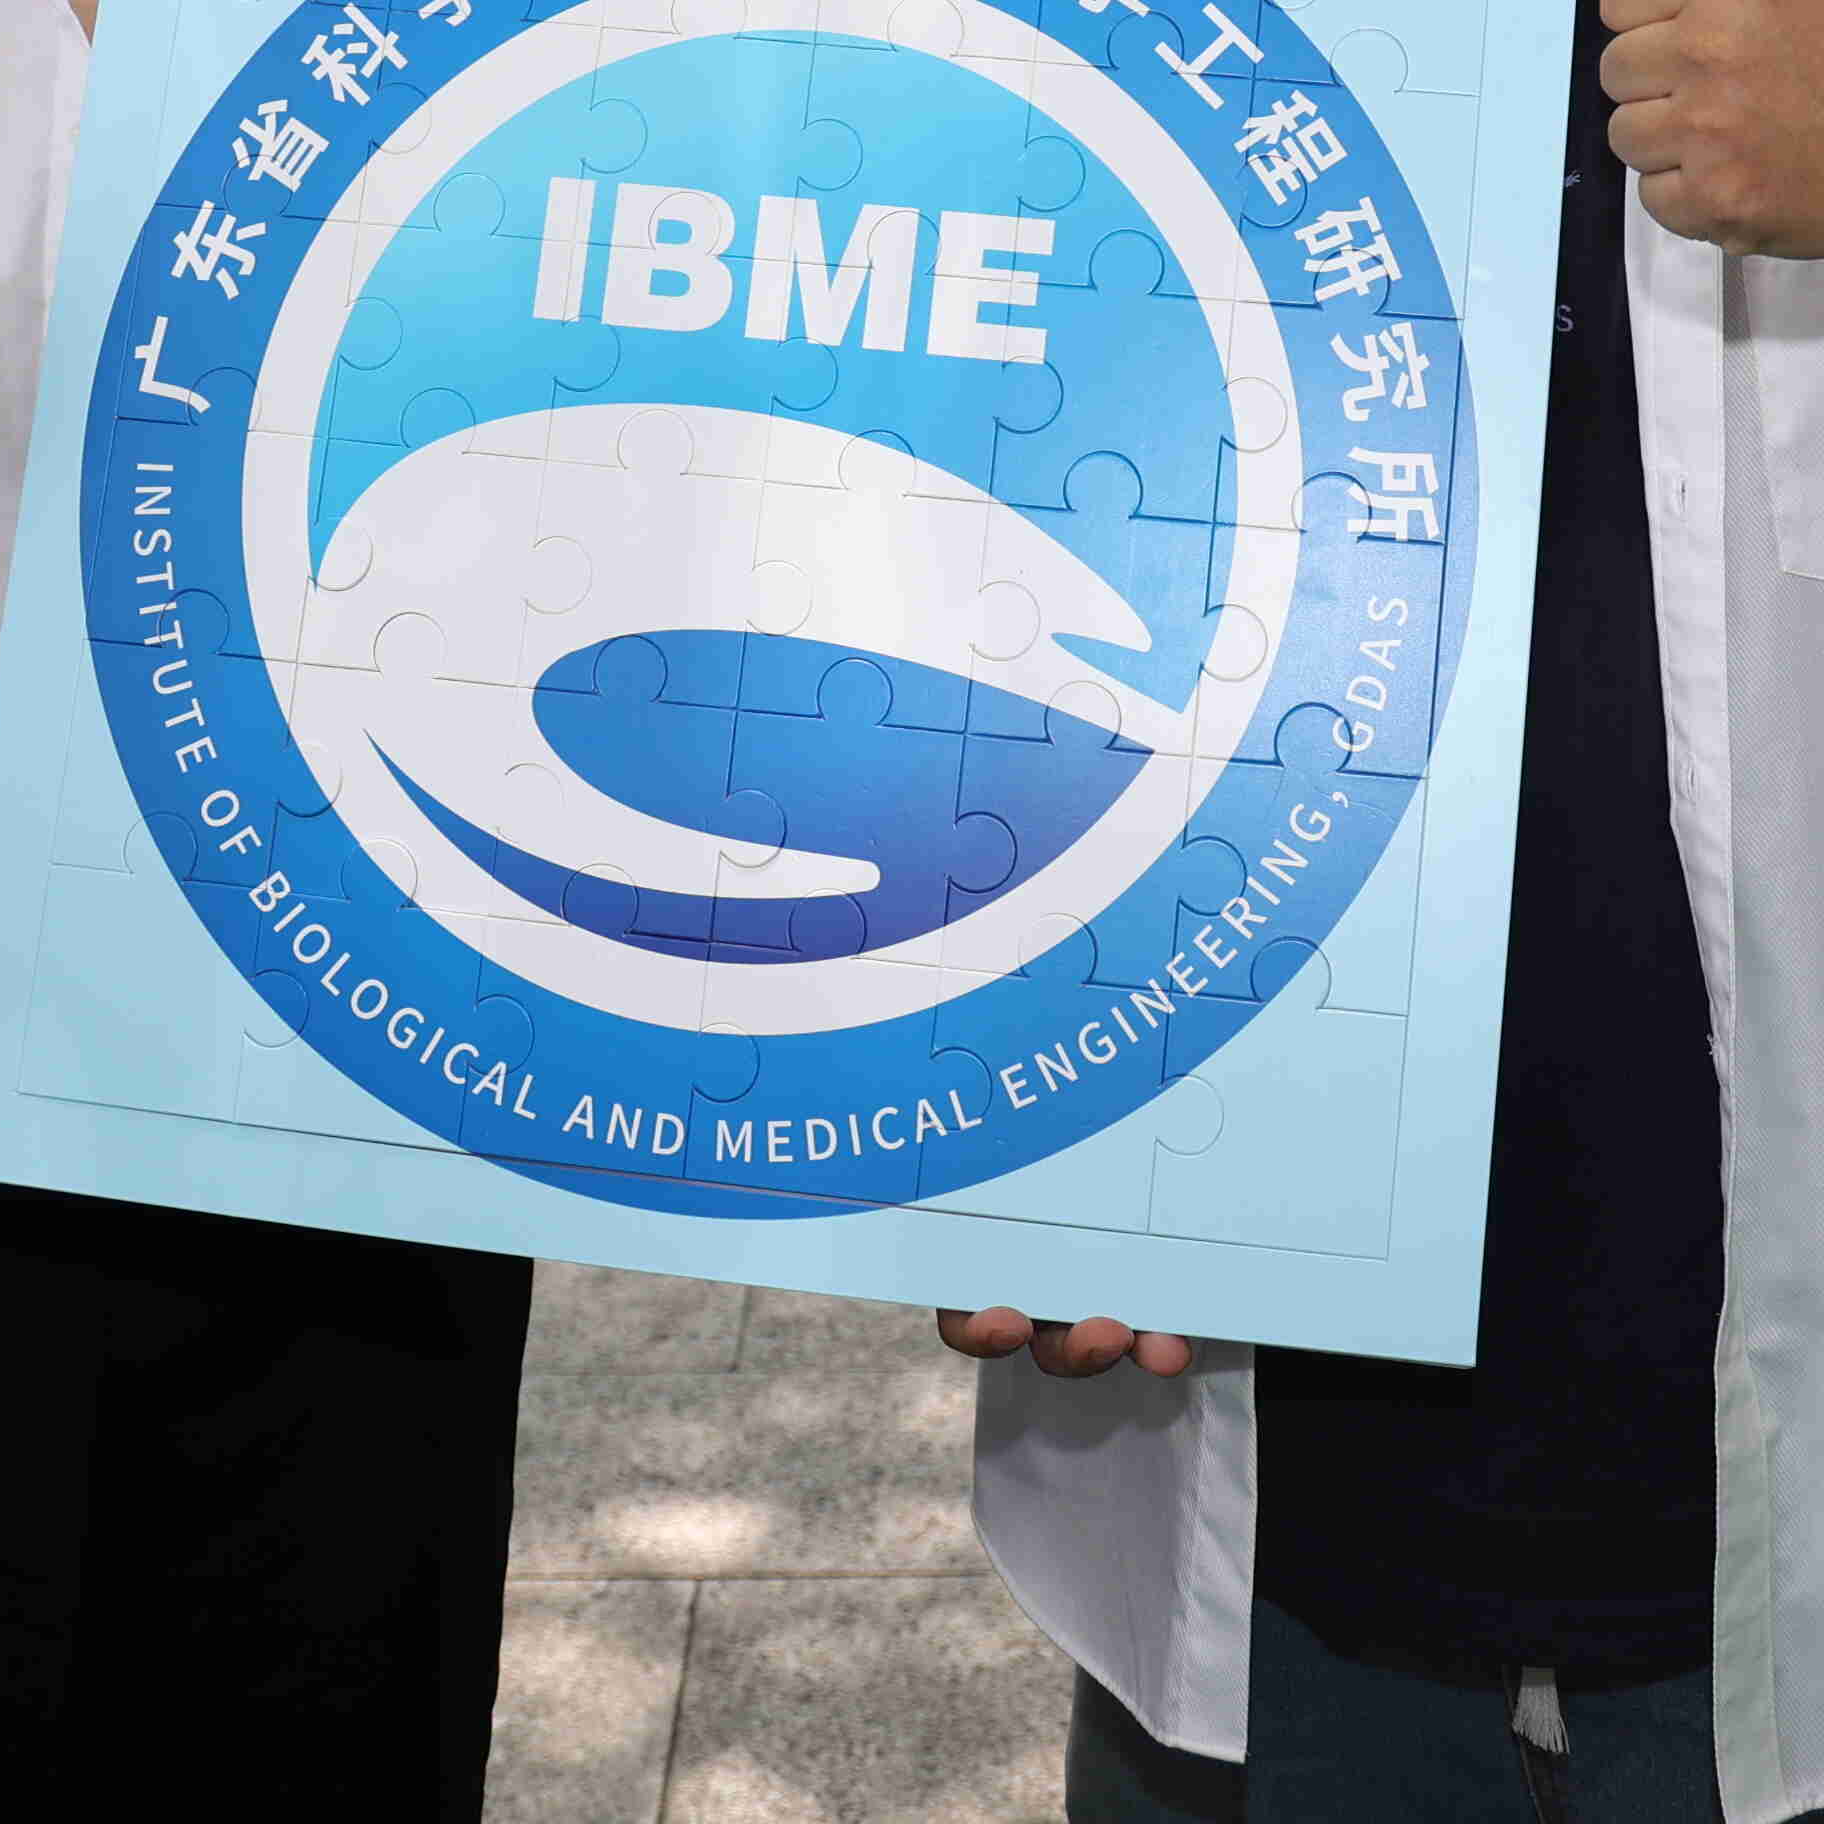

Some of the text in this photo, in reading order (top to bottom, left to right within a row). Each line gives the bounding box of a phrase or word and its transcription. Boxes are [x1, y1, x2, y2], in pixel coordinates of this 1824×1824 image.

[532, 177, 1054, 365] IBME
[133, 462, 1407, 1163] INSTITUTE OF BIOLOGICAL AND MEDICAL ENGINEERING, GDAS
